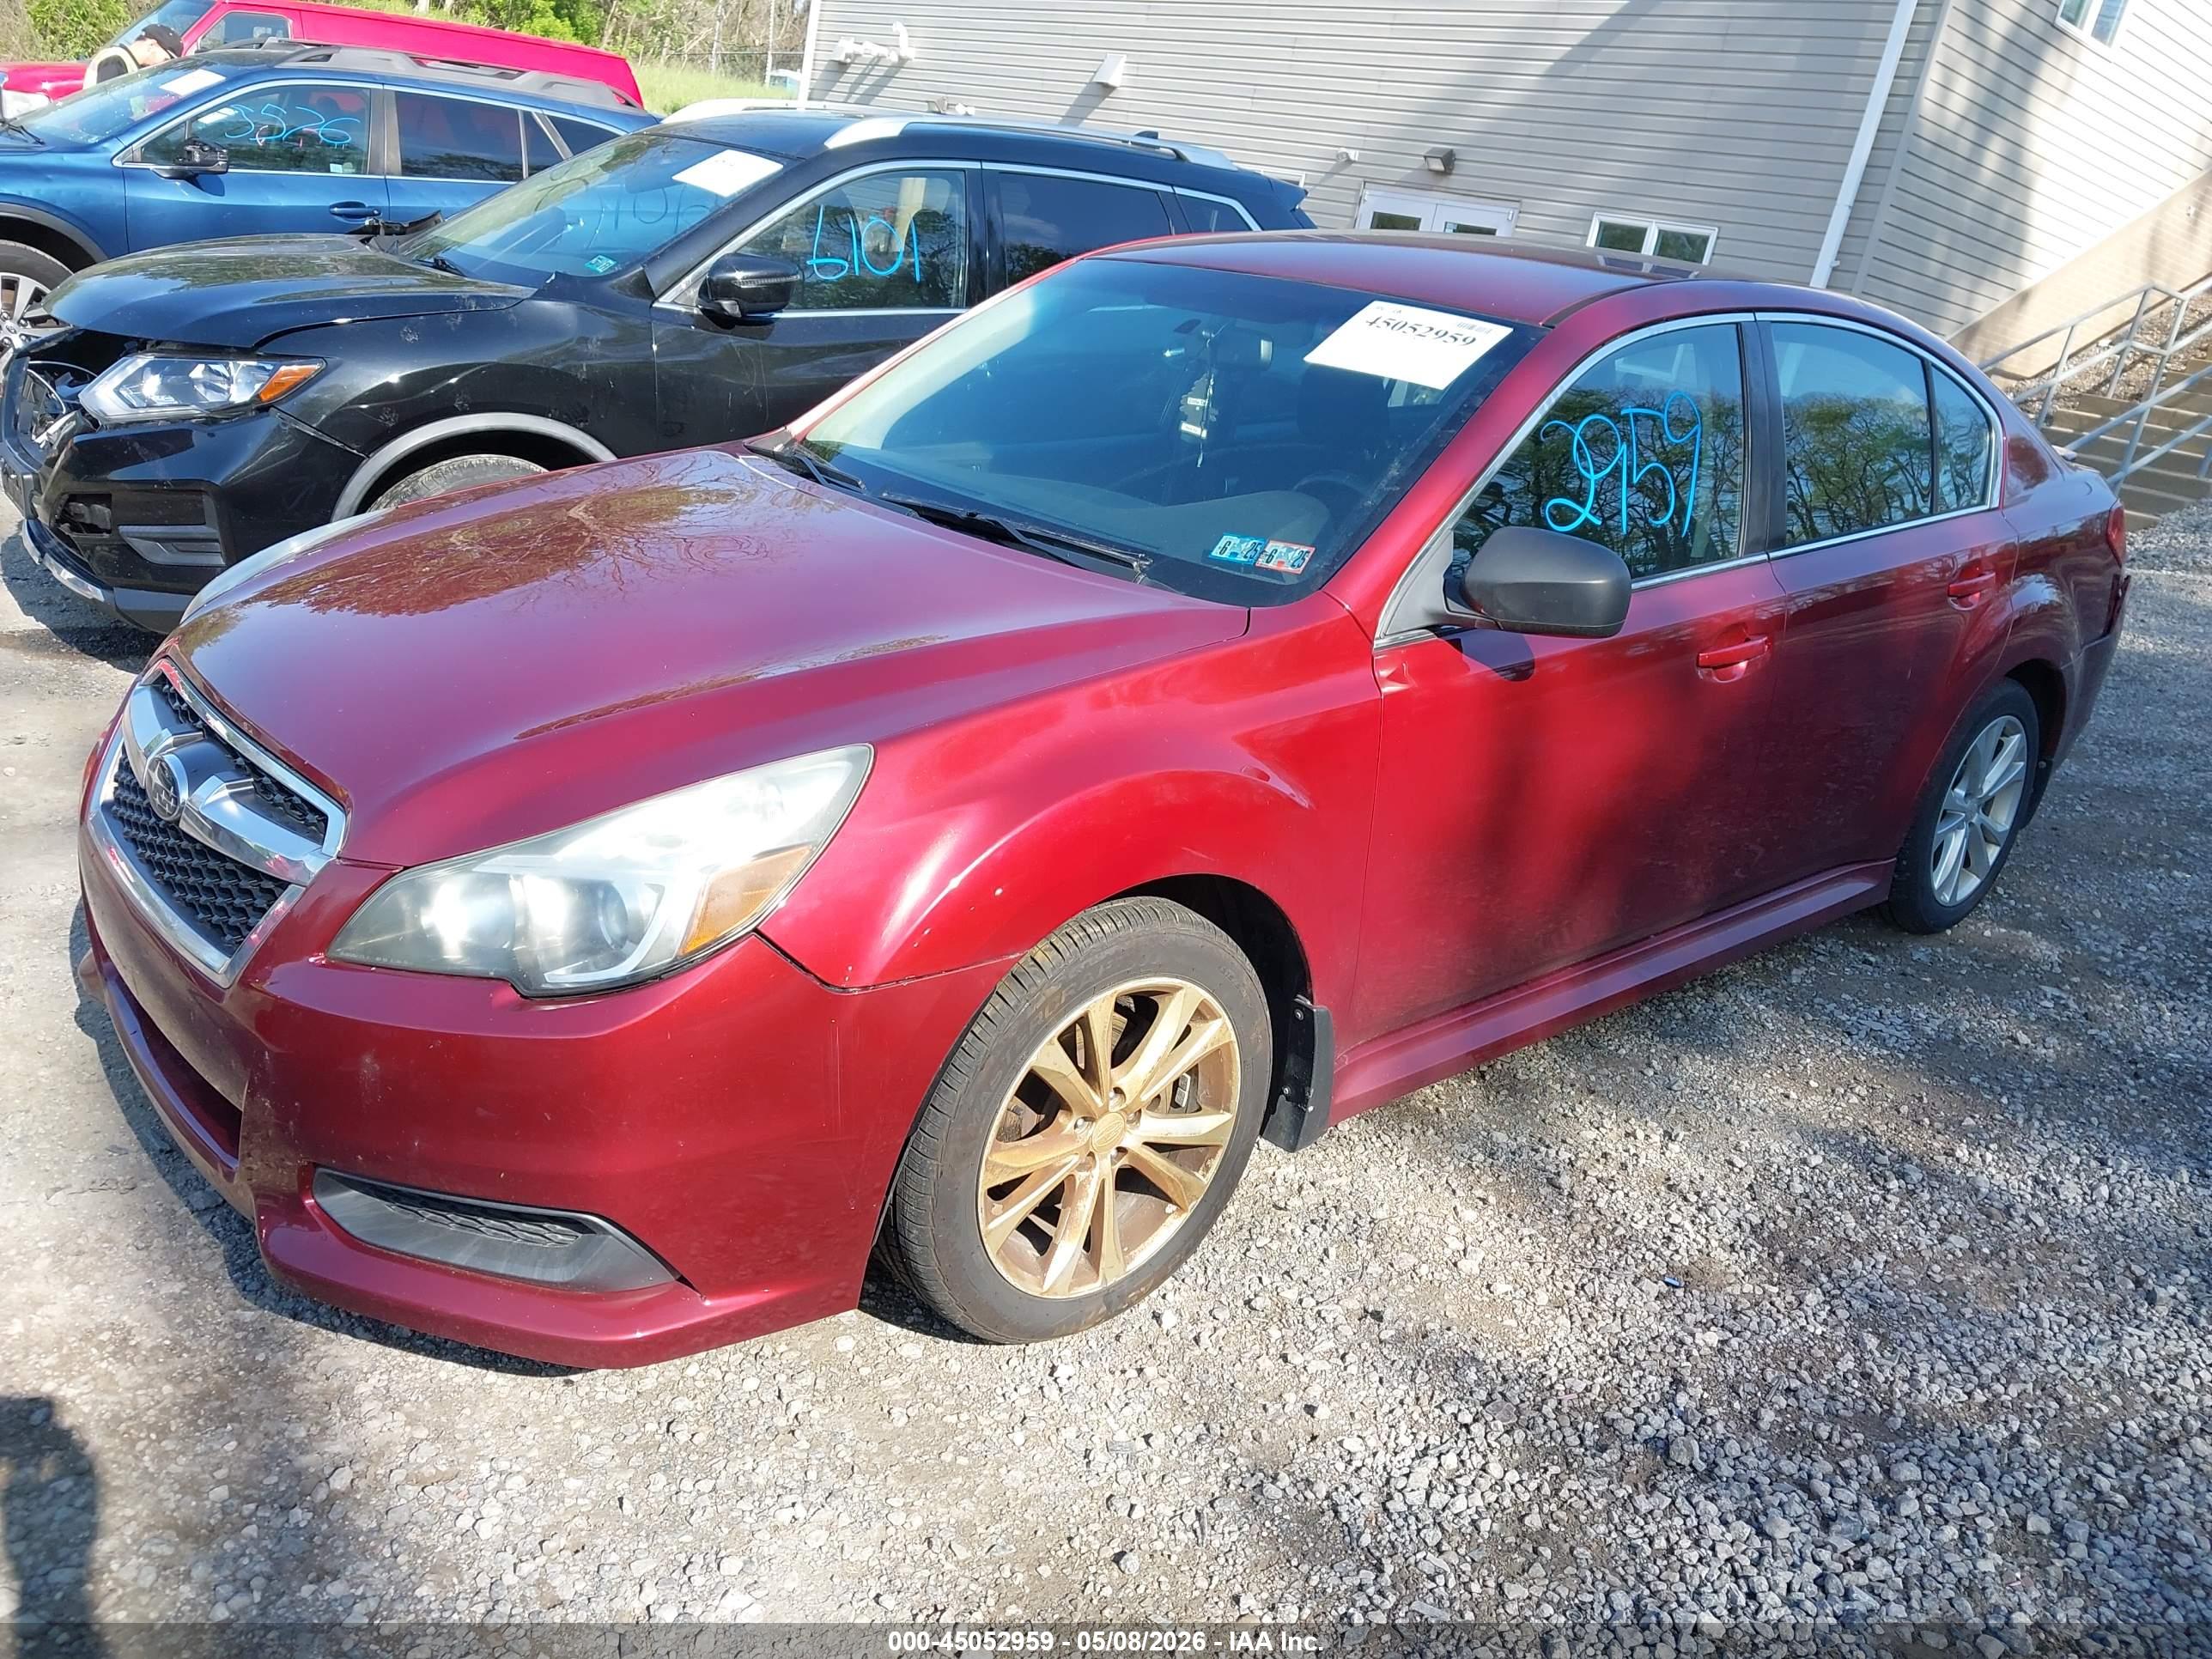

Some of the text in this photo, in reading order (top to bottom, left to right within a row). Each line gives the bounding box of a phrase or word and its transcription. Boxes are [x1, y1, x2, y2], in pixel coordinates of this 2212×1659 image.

[1365, 315, 1477, 346] 45052959
[1540, 391, 1702, 538] 2959
[1218, 540, 1263, 560] 6 25
[1265, 548, 1311, 569] 6 25
